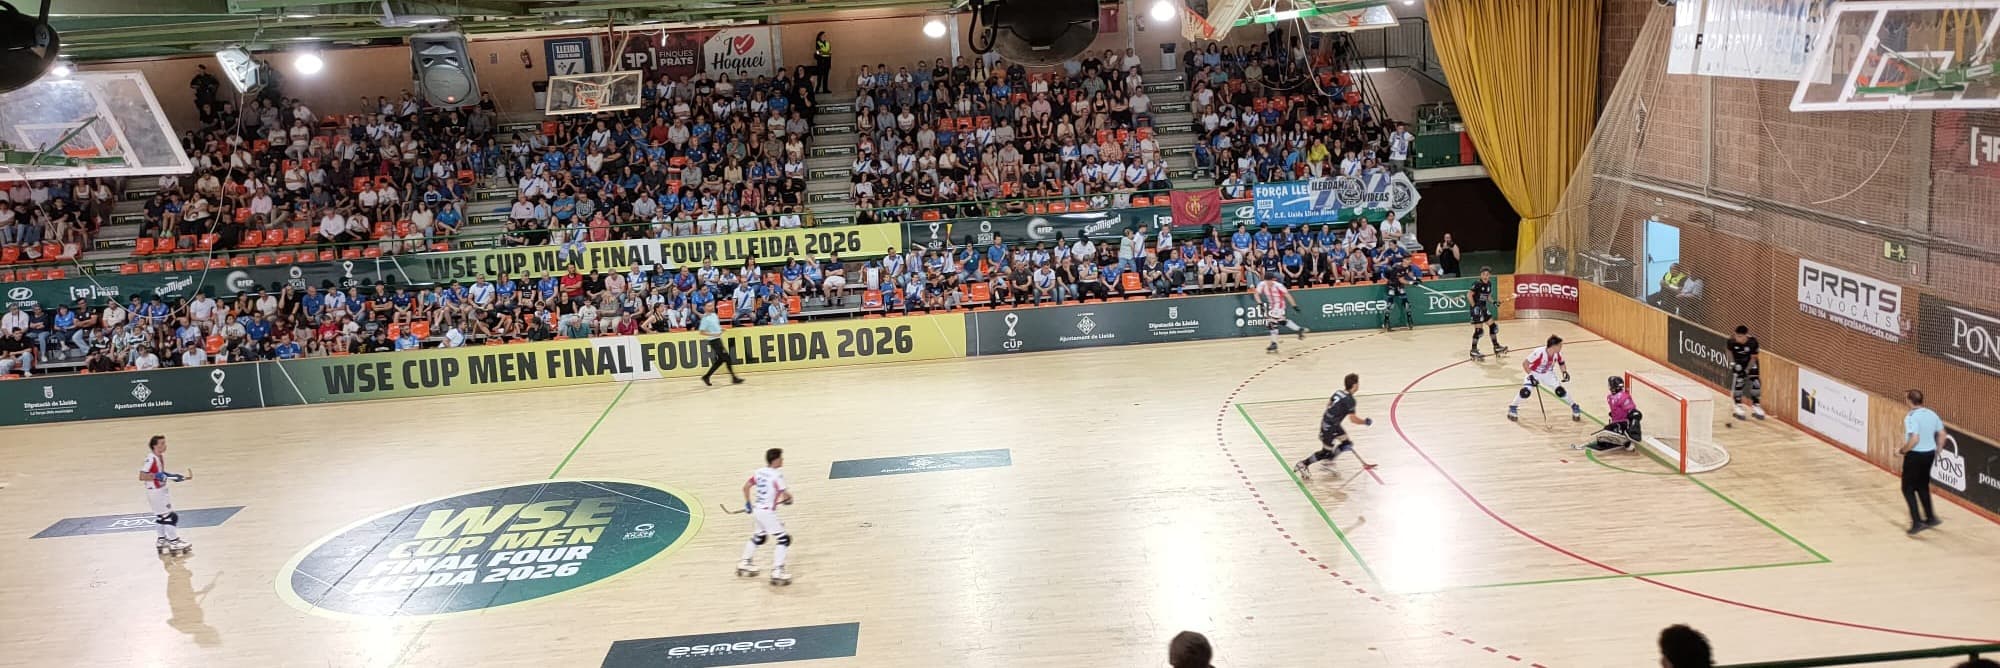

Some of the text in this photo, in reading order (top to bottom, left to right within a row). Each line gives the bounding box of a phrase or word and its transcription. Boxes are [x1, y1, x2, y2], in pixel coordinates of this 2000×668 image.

[660, 57, 694, 66] PRATS
[711, 51, 766, 75] Hoquei
[1256, 186, 1288, 199] FORÇA
[426, 230, 861, 280] WSE CUP MEN FINAL FOUR LLEIDA 2026
[1516, 283, 1578, 298] esmeca
[1803, 266, 1897, 313] PRATS
[1322, 300, 1387, 314] esmeca
[1429, 295, 1466, 310] PONS
[1805, 290, 1892, 328] ADVOCATS
[1003, 340, 1023, 349] CUP
[322, 325, 913, 394] WSE CUP MEN FINAL FOUR LLEIDA 2026
[211, 397, 232, 406] CUP
[414, 498, 619, 540] WSE
[389, 536, 485, 559] CUP
[488, 526, 606, 551] MEN
[367, 545, 593, 577] FINAL FOUR
[351, 562, 582, 594] LLEIDA 2026
[668, 638, 796, 656] esmeca
